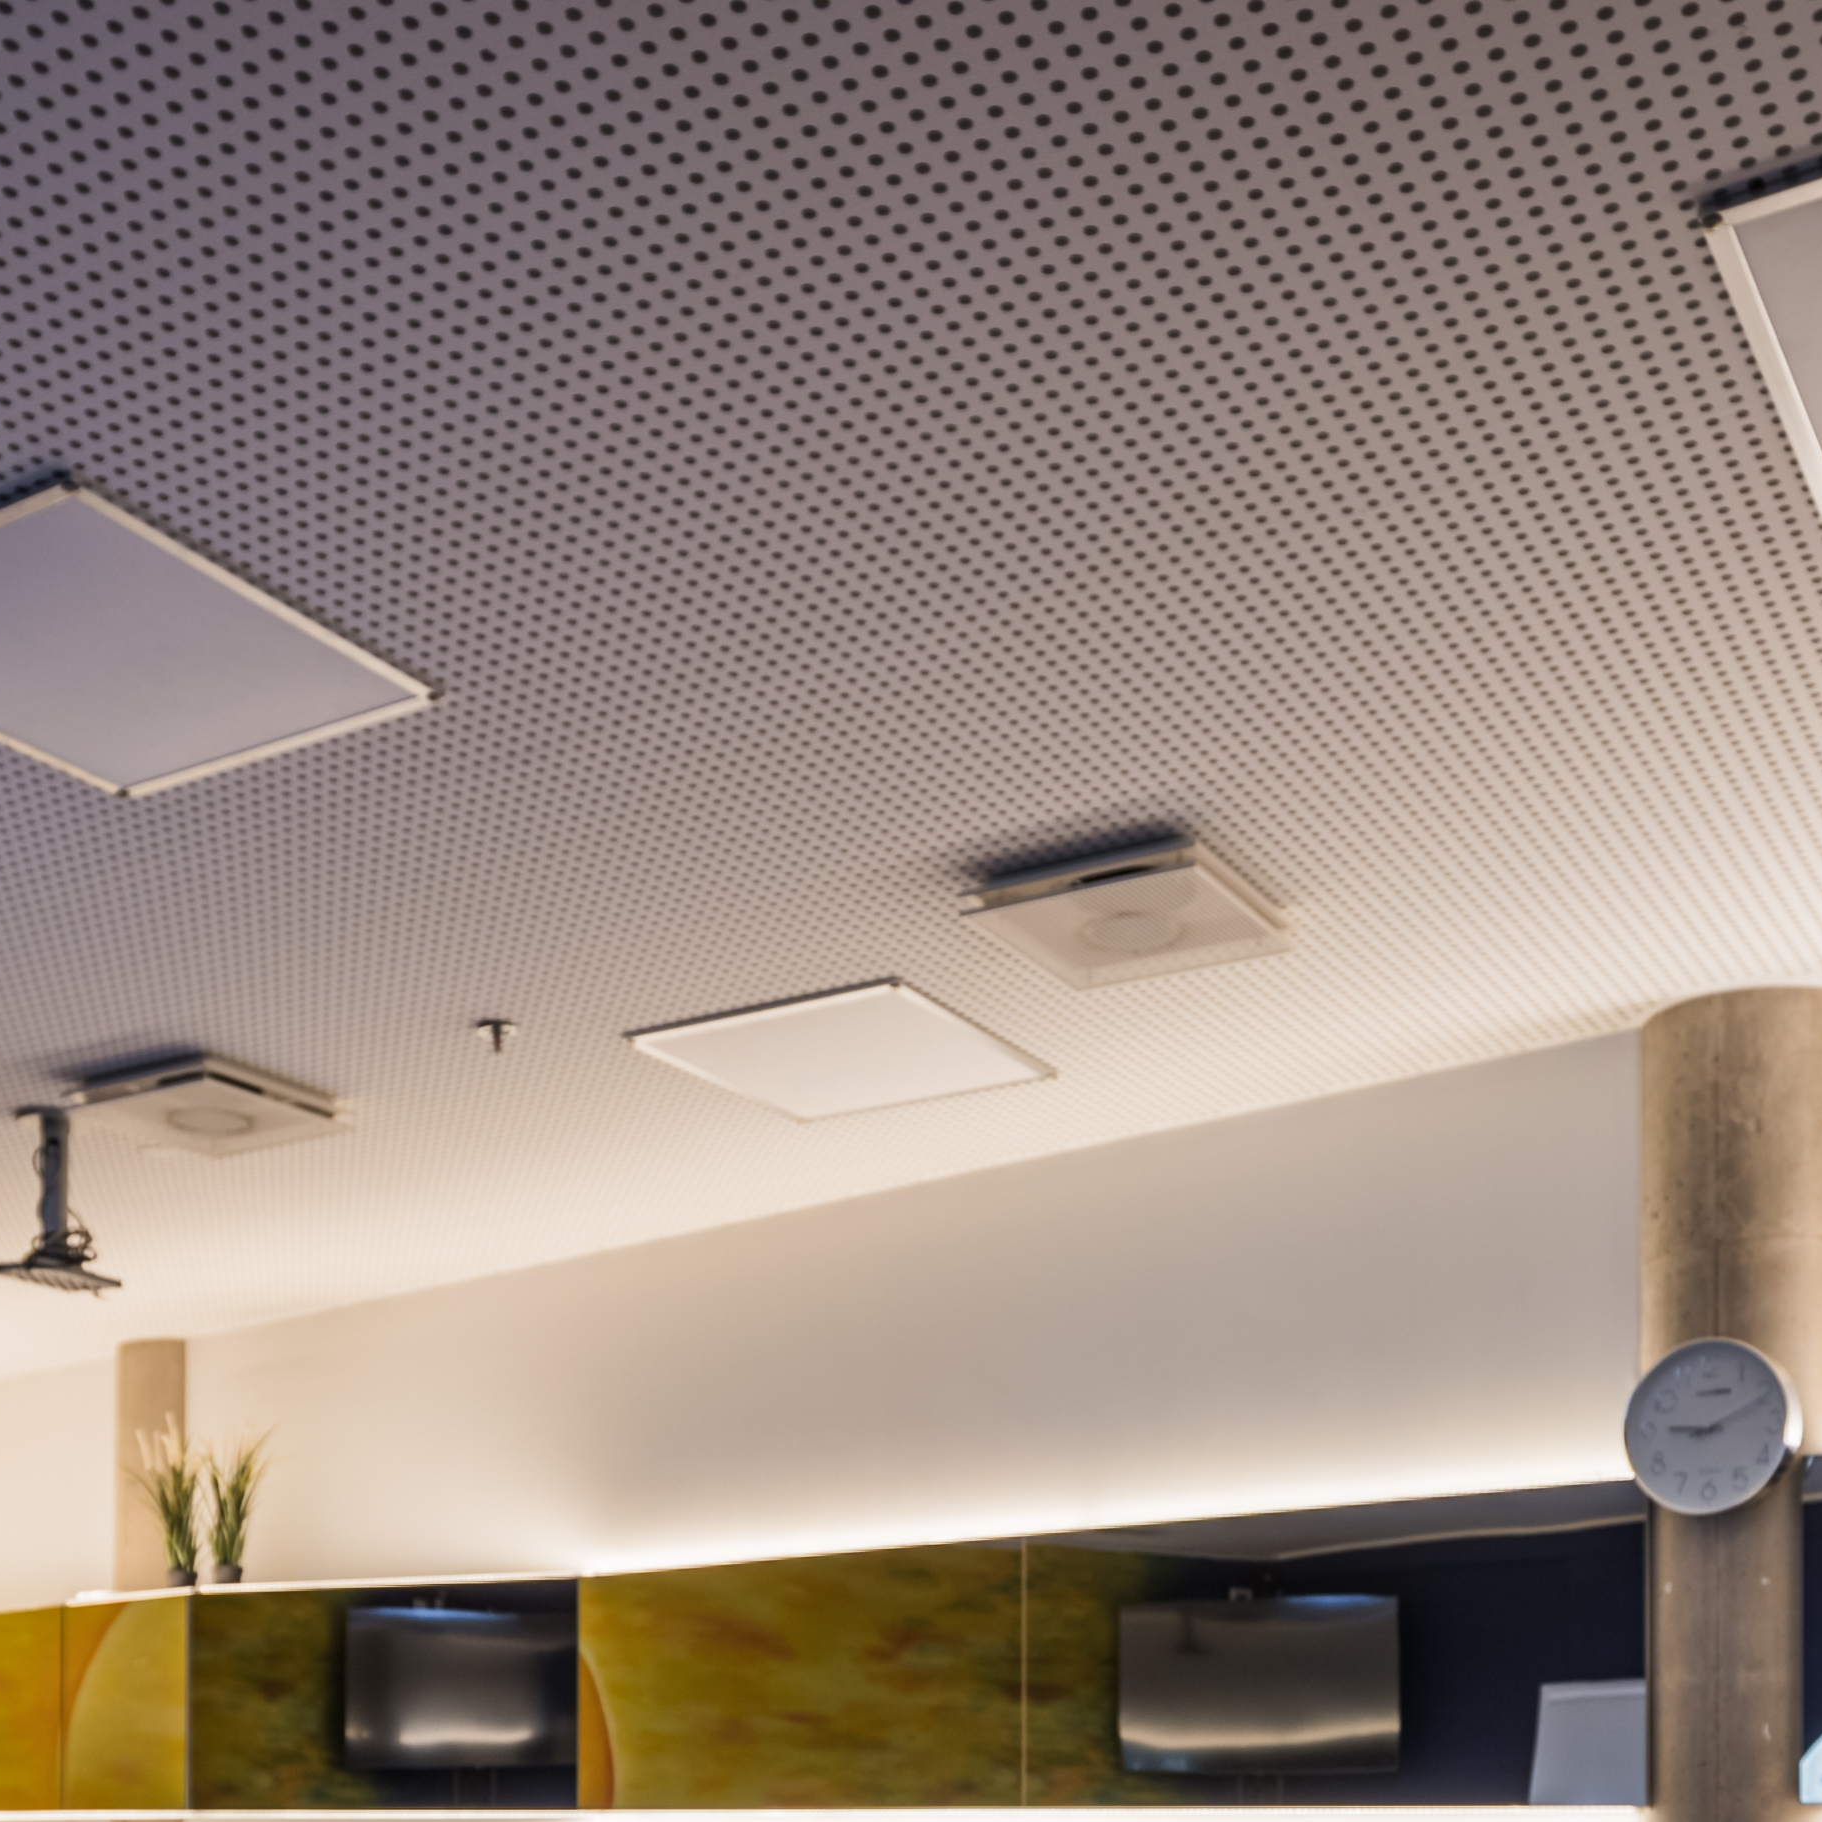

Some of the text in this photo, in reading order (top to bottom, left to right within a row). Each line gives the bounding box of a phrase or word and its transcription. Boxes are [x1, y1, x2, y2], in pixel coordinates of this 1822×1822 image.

[1650, 1449, 1666, 1476] 8
[1756, 1442, 1770, 1465] 4
[1673, 1471, 1688, 1496] 7
[1700, 1479, 1718, 1502] 6
[1733, 1465, 1750, 1491] 5
